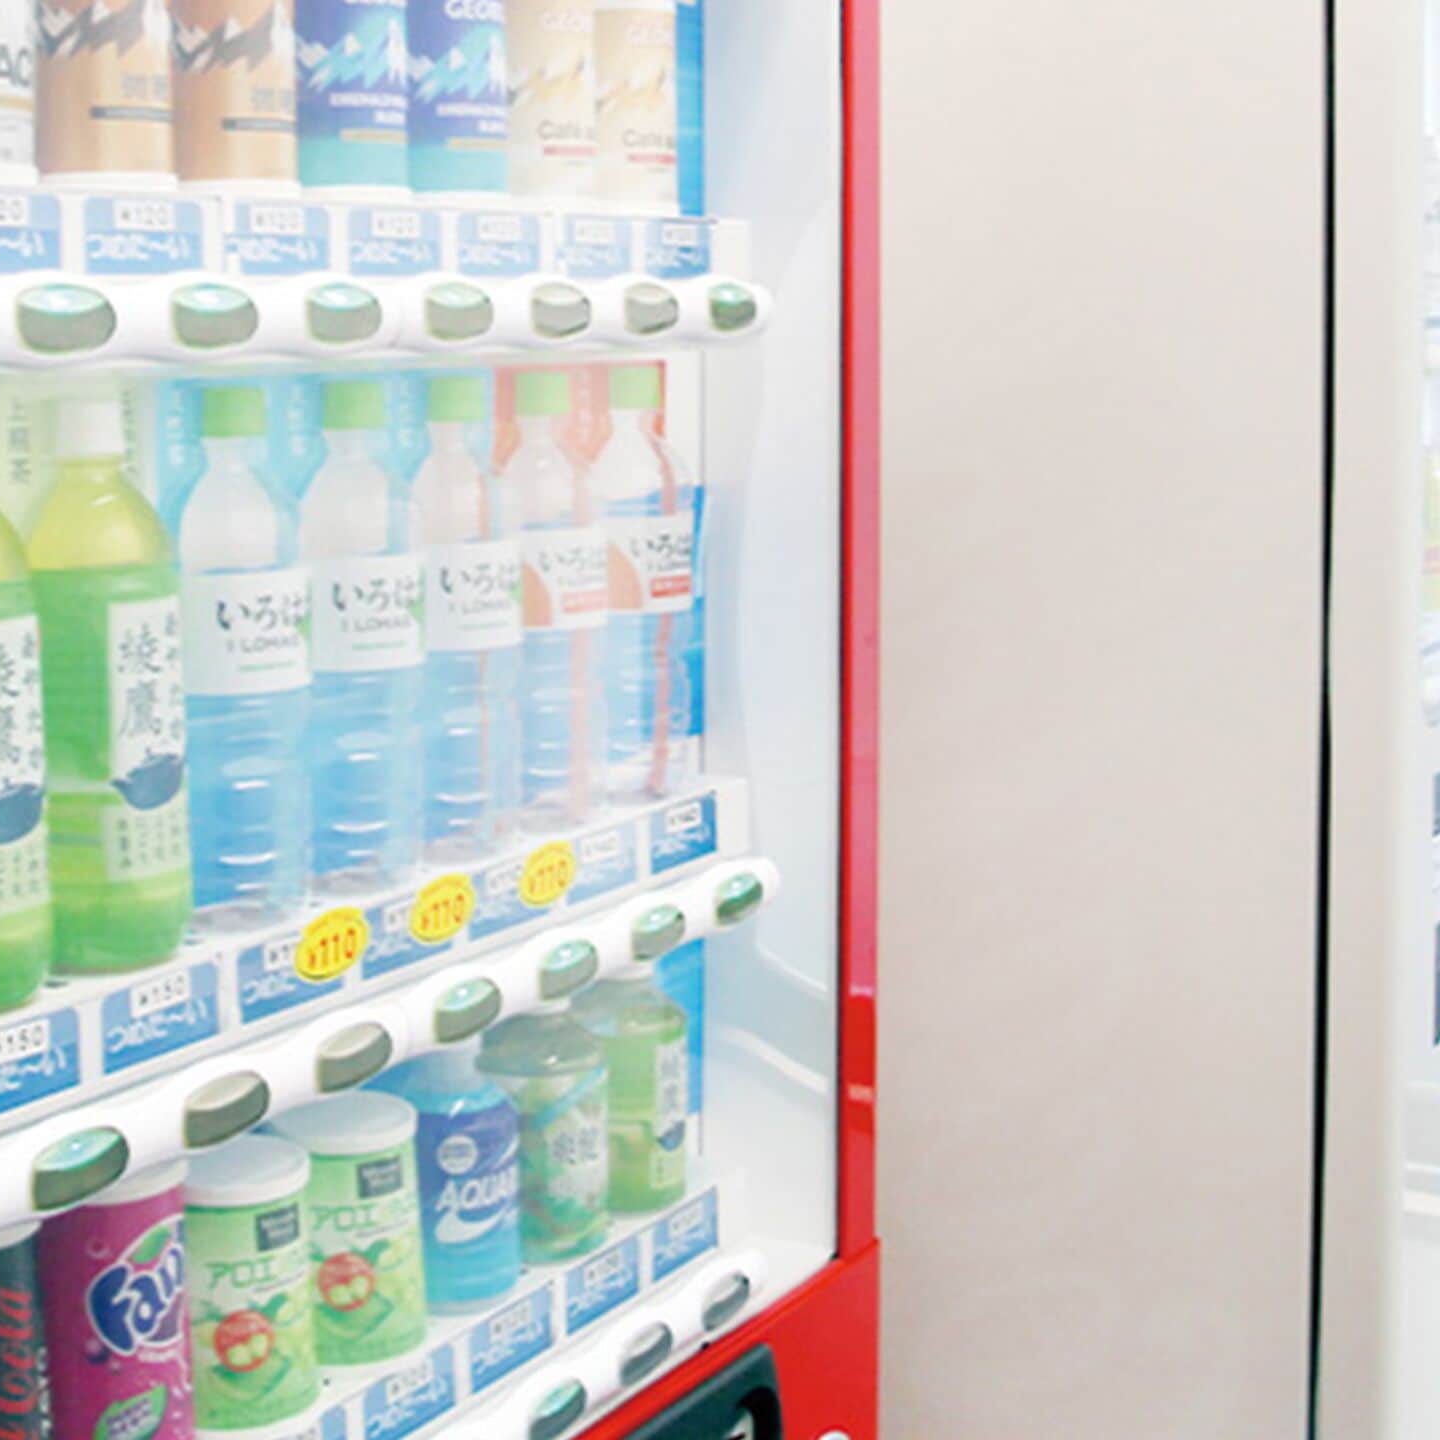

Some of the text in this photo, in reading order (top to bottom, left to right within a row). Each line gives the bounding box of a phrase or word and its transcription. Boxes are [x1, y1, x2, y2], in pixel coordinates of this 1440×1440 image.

[116, 623, 162, 738] 綾鷹
[419, 890, 467, 933] ¥110
[305, 924, 357, 971] ¥110
[137, 973, 188, 1008] ¥150
